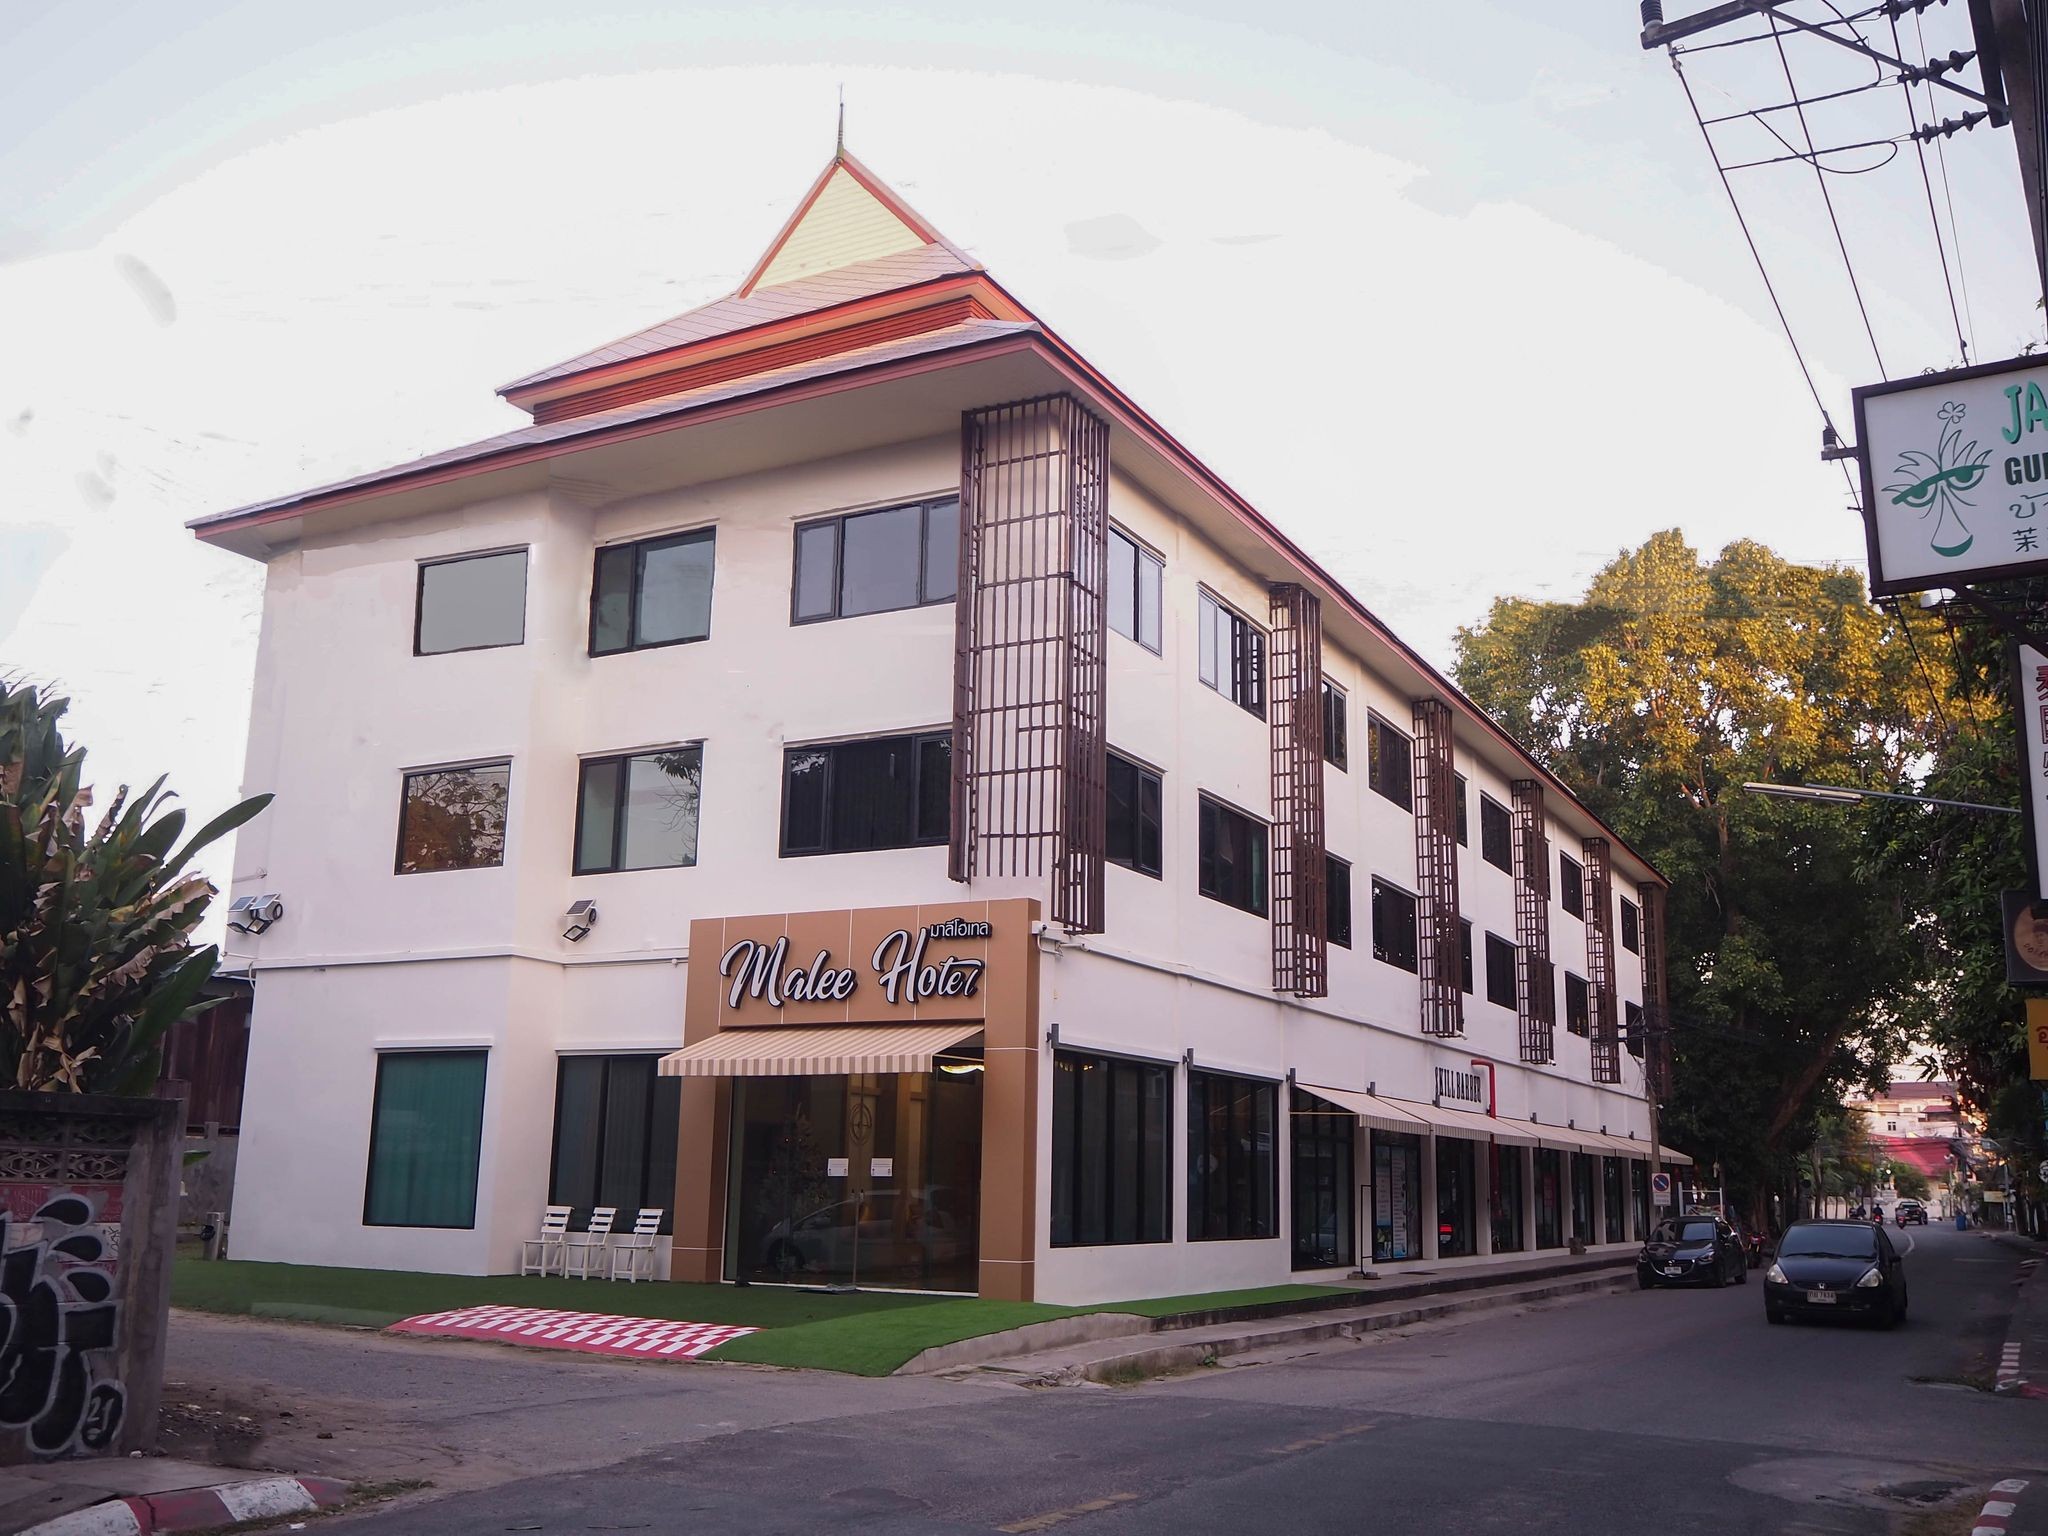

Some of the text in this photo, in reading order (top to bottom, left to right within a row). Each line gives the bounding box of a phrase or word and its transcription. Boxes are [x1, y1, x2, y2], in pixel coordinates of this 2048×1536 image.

[2012, 526, 2048, 553] 茉
[929, 917, 992, 939] มาลีโอเทล
[719, 927, 986, 1009] Malee Hotel
[1435, 1066, 1482, 1103] SKILL BARBER
